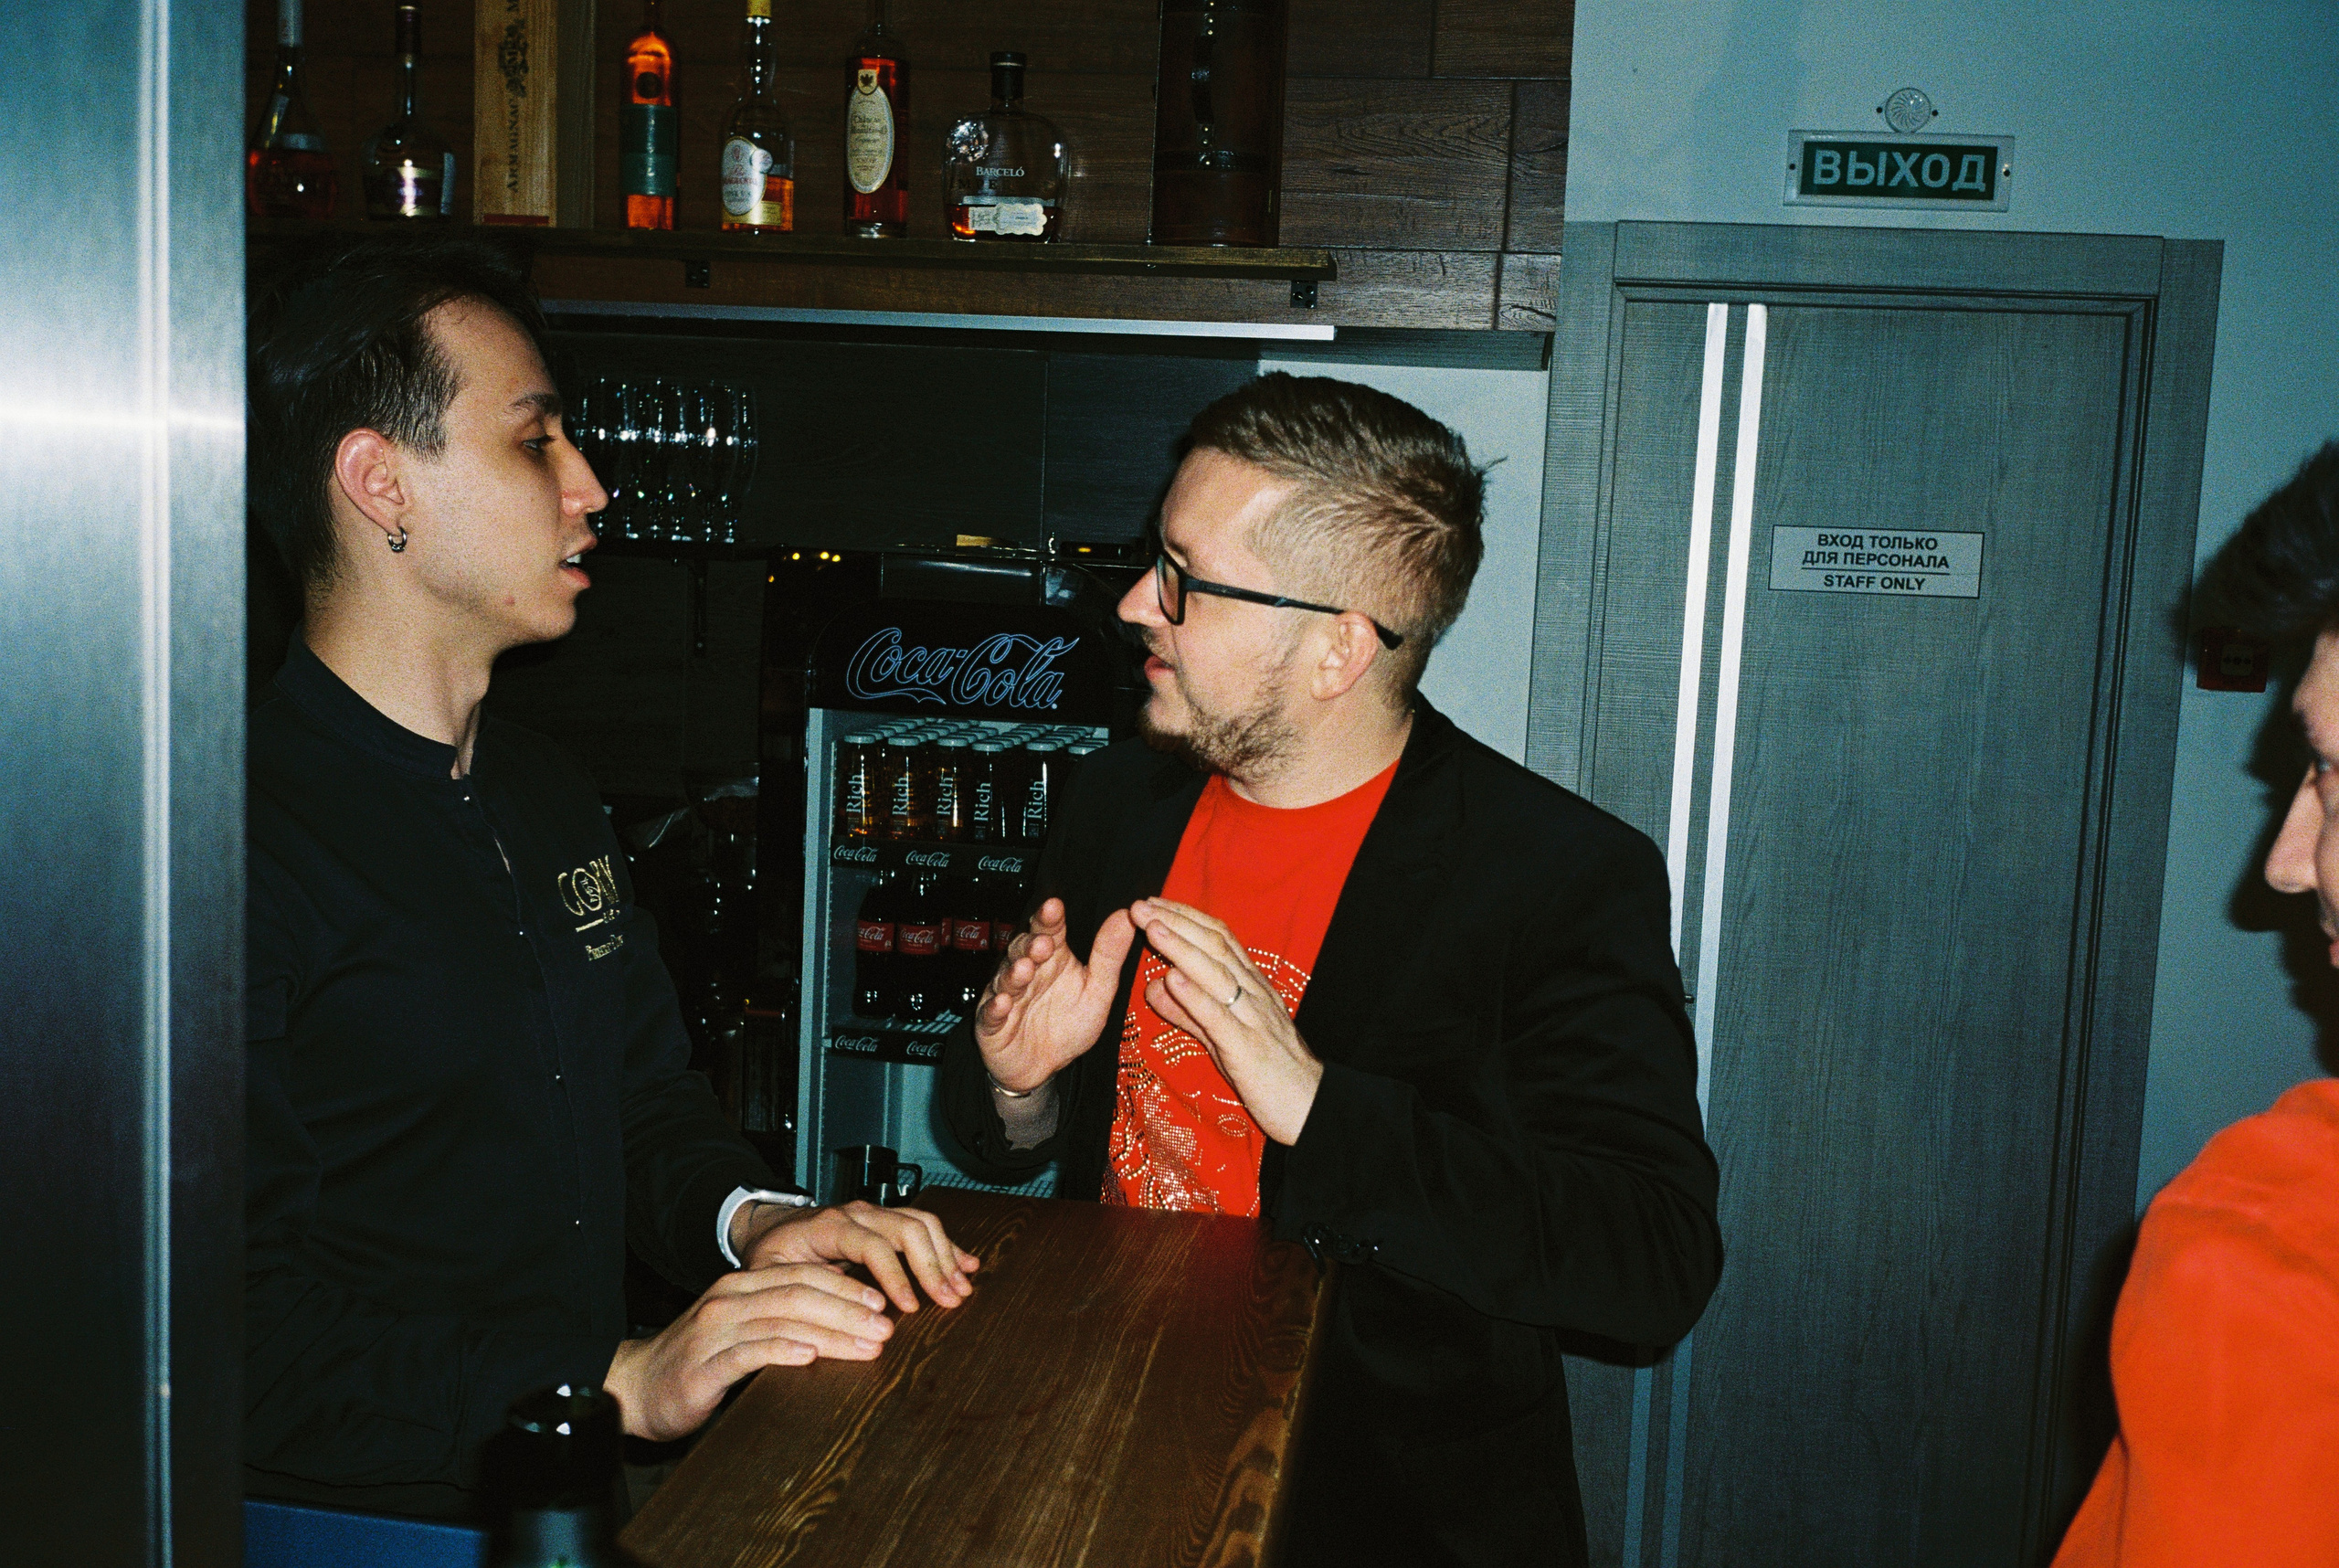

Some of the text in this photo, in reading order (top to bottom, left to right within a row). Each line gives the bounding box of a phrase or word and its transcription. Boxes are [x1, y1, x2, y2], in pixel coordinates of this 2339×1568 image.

[976, 166, 1025, 177] BARCELÓ
[1812, 149, 1986, 193] ВЫХОД
[1802, 551, 1950, 568] ДЛЯ ПЕРСОНАЛА
[1817, 534, 1938, 550] ВХОД ТОЛЬКО
[1823, 575, 1926, 590] STAFF ONLY
[847, 627, 1080, 709] Coca-Cola
[846, 774, 864, 813] Rich
[892, 777, 909, 816] Rich
[937, 777, 953, 816] Rich
[973, 782, 991, 821] Rich
[1027, 780, 1045, 820] Rich
